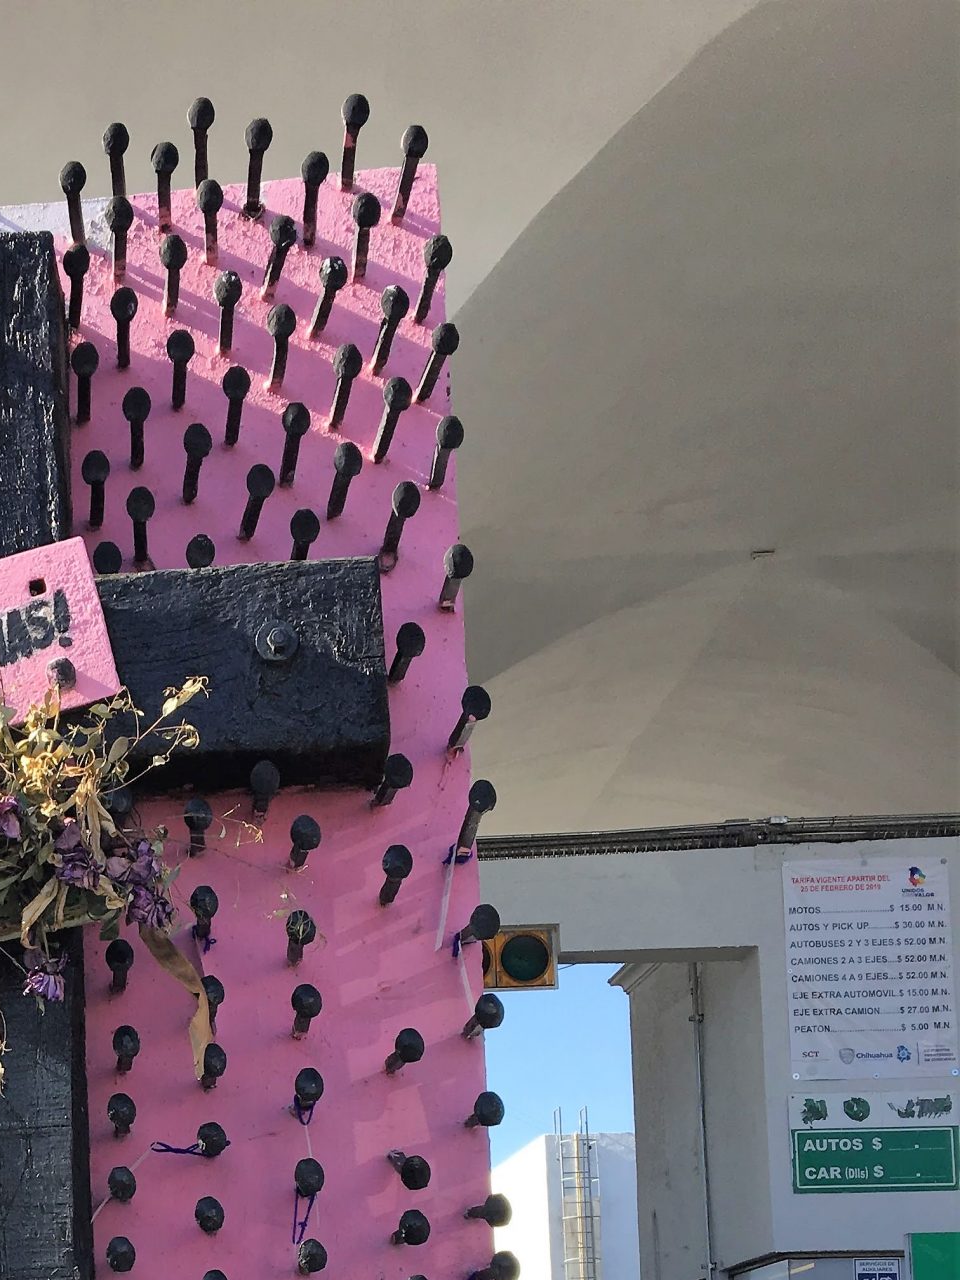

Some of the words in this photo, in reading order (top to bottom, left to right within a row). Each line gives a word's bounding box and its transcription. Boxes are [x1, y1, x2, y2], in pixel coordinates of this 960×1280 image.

[832, 922, 853, 930] PICK
[790, 940, 845, 948] AUTOBUSES
[904, 937, 926, 945] 52.00
[791, 957, 838, 965] CAMIONES
[793, 991, 808, 1000] EJE
[812, 991, 842, 999] EXTRA
[844, 990, 895, 998] AUTOMOVIL
[907, 988, 929, 996] 15.00
[794, 1008, 810, 1016] EJE
[813, 1008, 842, 1016] EXTRA
[804, 1138, 863, 1152] AUTOS
[872, 1137, 882, 1150] $
[805, 1167, 842, 1180] CAR
[873, 1166, 884, 1178] $
